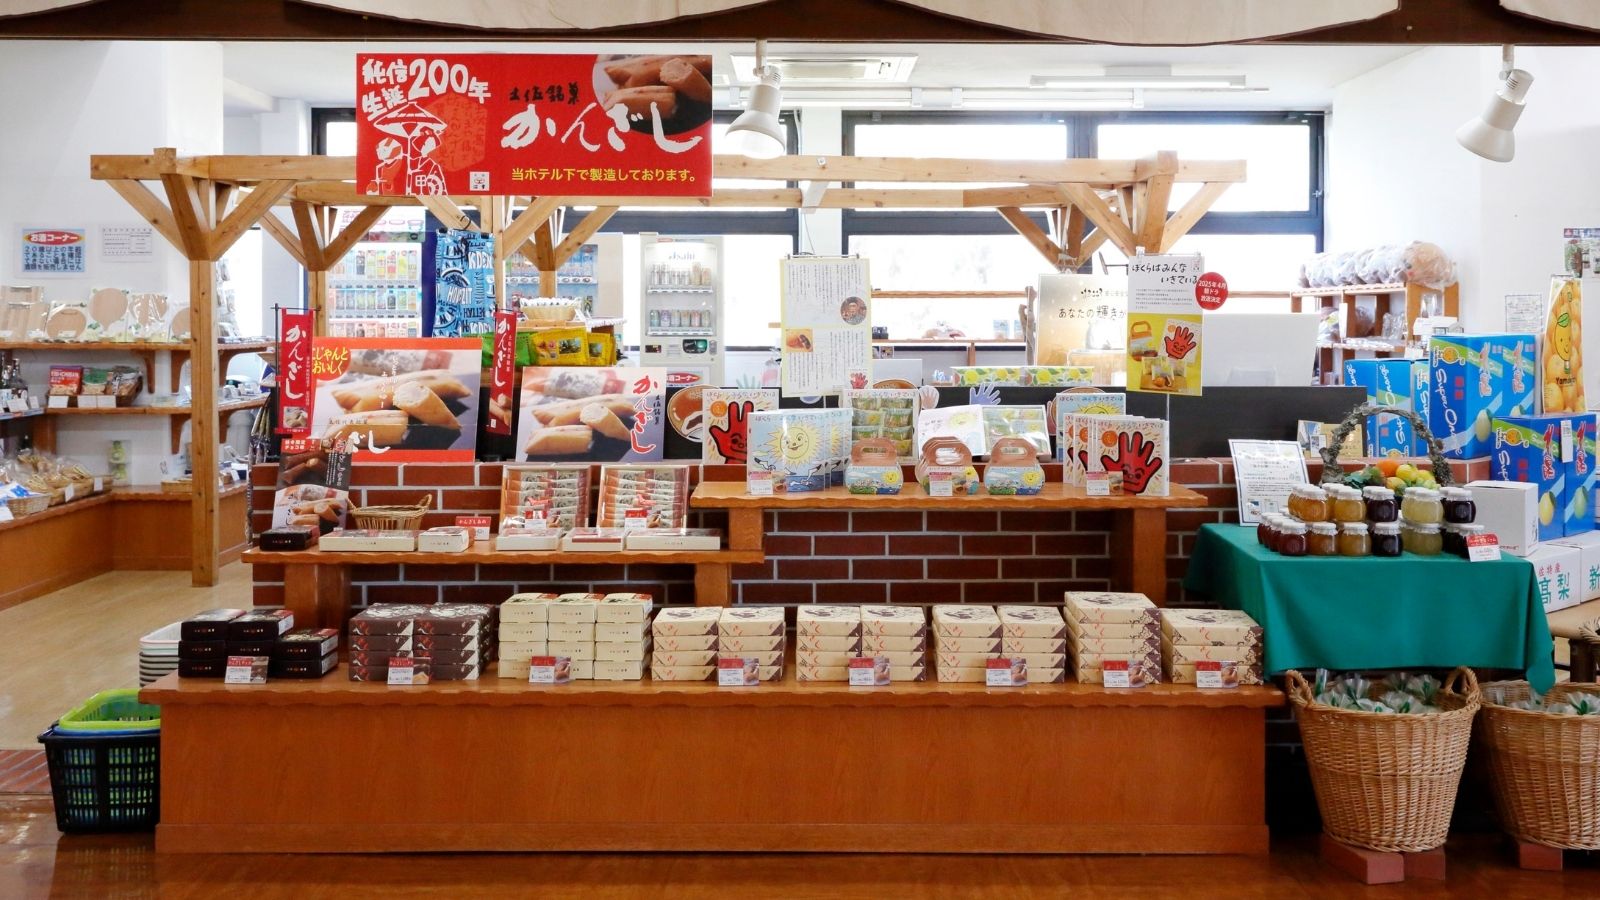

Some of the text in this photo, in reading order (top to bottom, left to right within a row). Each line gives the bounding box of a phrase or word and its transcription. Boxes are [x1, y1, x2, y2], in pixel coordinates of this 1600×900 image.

[407, 58, 491, 105] 200年
[500, 102, 704, 154] かんざし
[511, 167, 696, 182] 当ホテル下で製造しております。
[30, 233, 79, 242] お酒コーナー
[1132, 262, 1188, 274] ぼくらはみんな
[284, 325, 307, 400] かんざし
[312, 360, 343, 375] おいしく
[494, 318, 511, 387] かんざし
[1434, 368, 1449, 408] Super
[630, 375, 660, 454] かんざし
